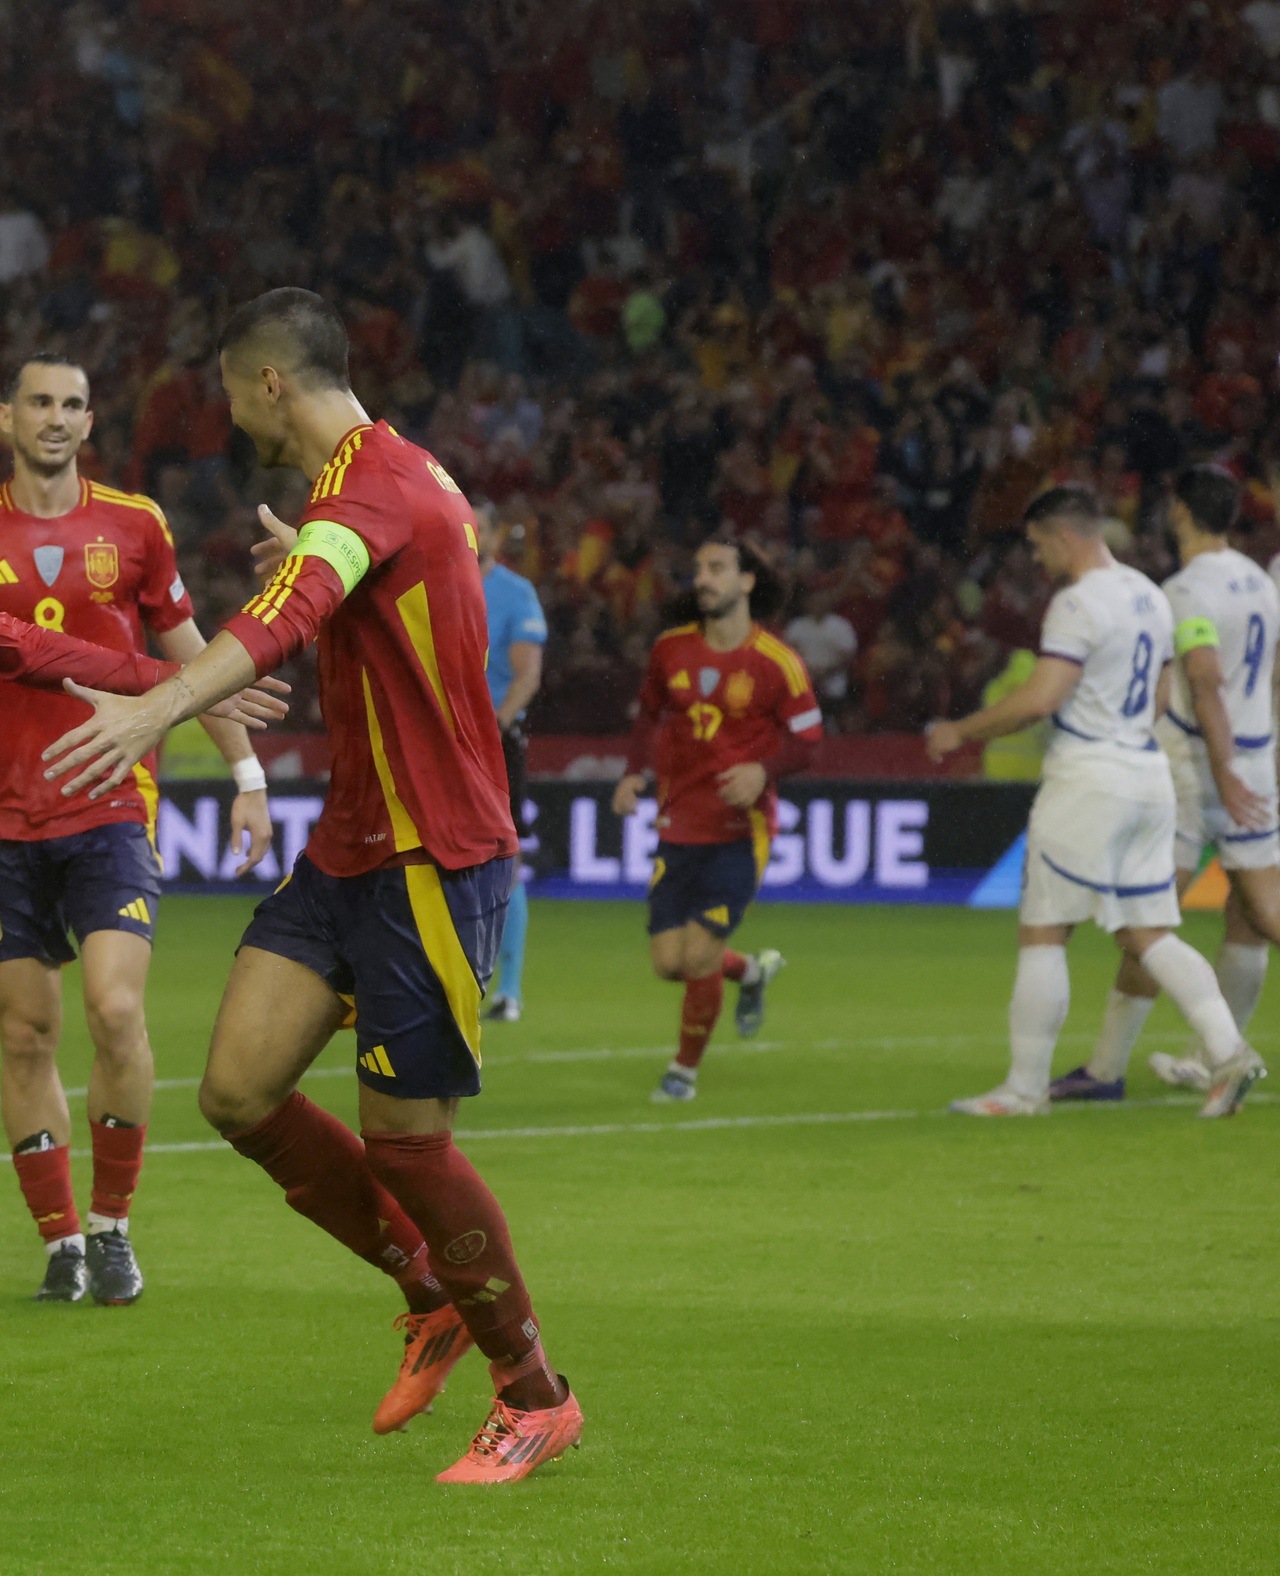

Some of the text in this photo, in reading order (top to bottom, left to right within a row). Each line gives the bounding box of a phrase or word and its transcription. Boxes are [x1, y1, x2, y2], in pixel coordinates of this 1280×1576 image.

[340, 543, 361, 579] RESPE
[1122, 631, 1153, 717] 8
[1245, 613, 1265, 697] 9
[688, 702, 723, 741] 17
[570, 797, 930, 888] LEGUE
